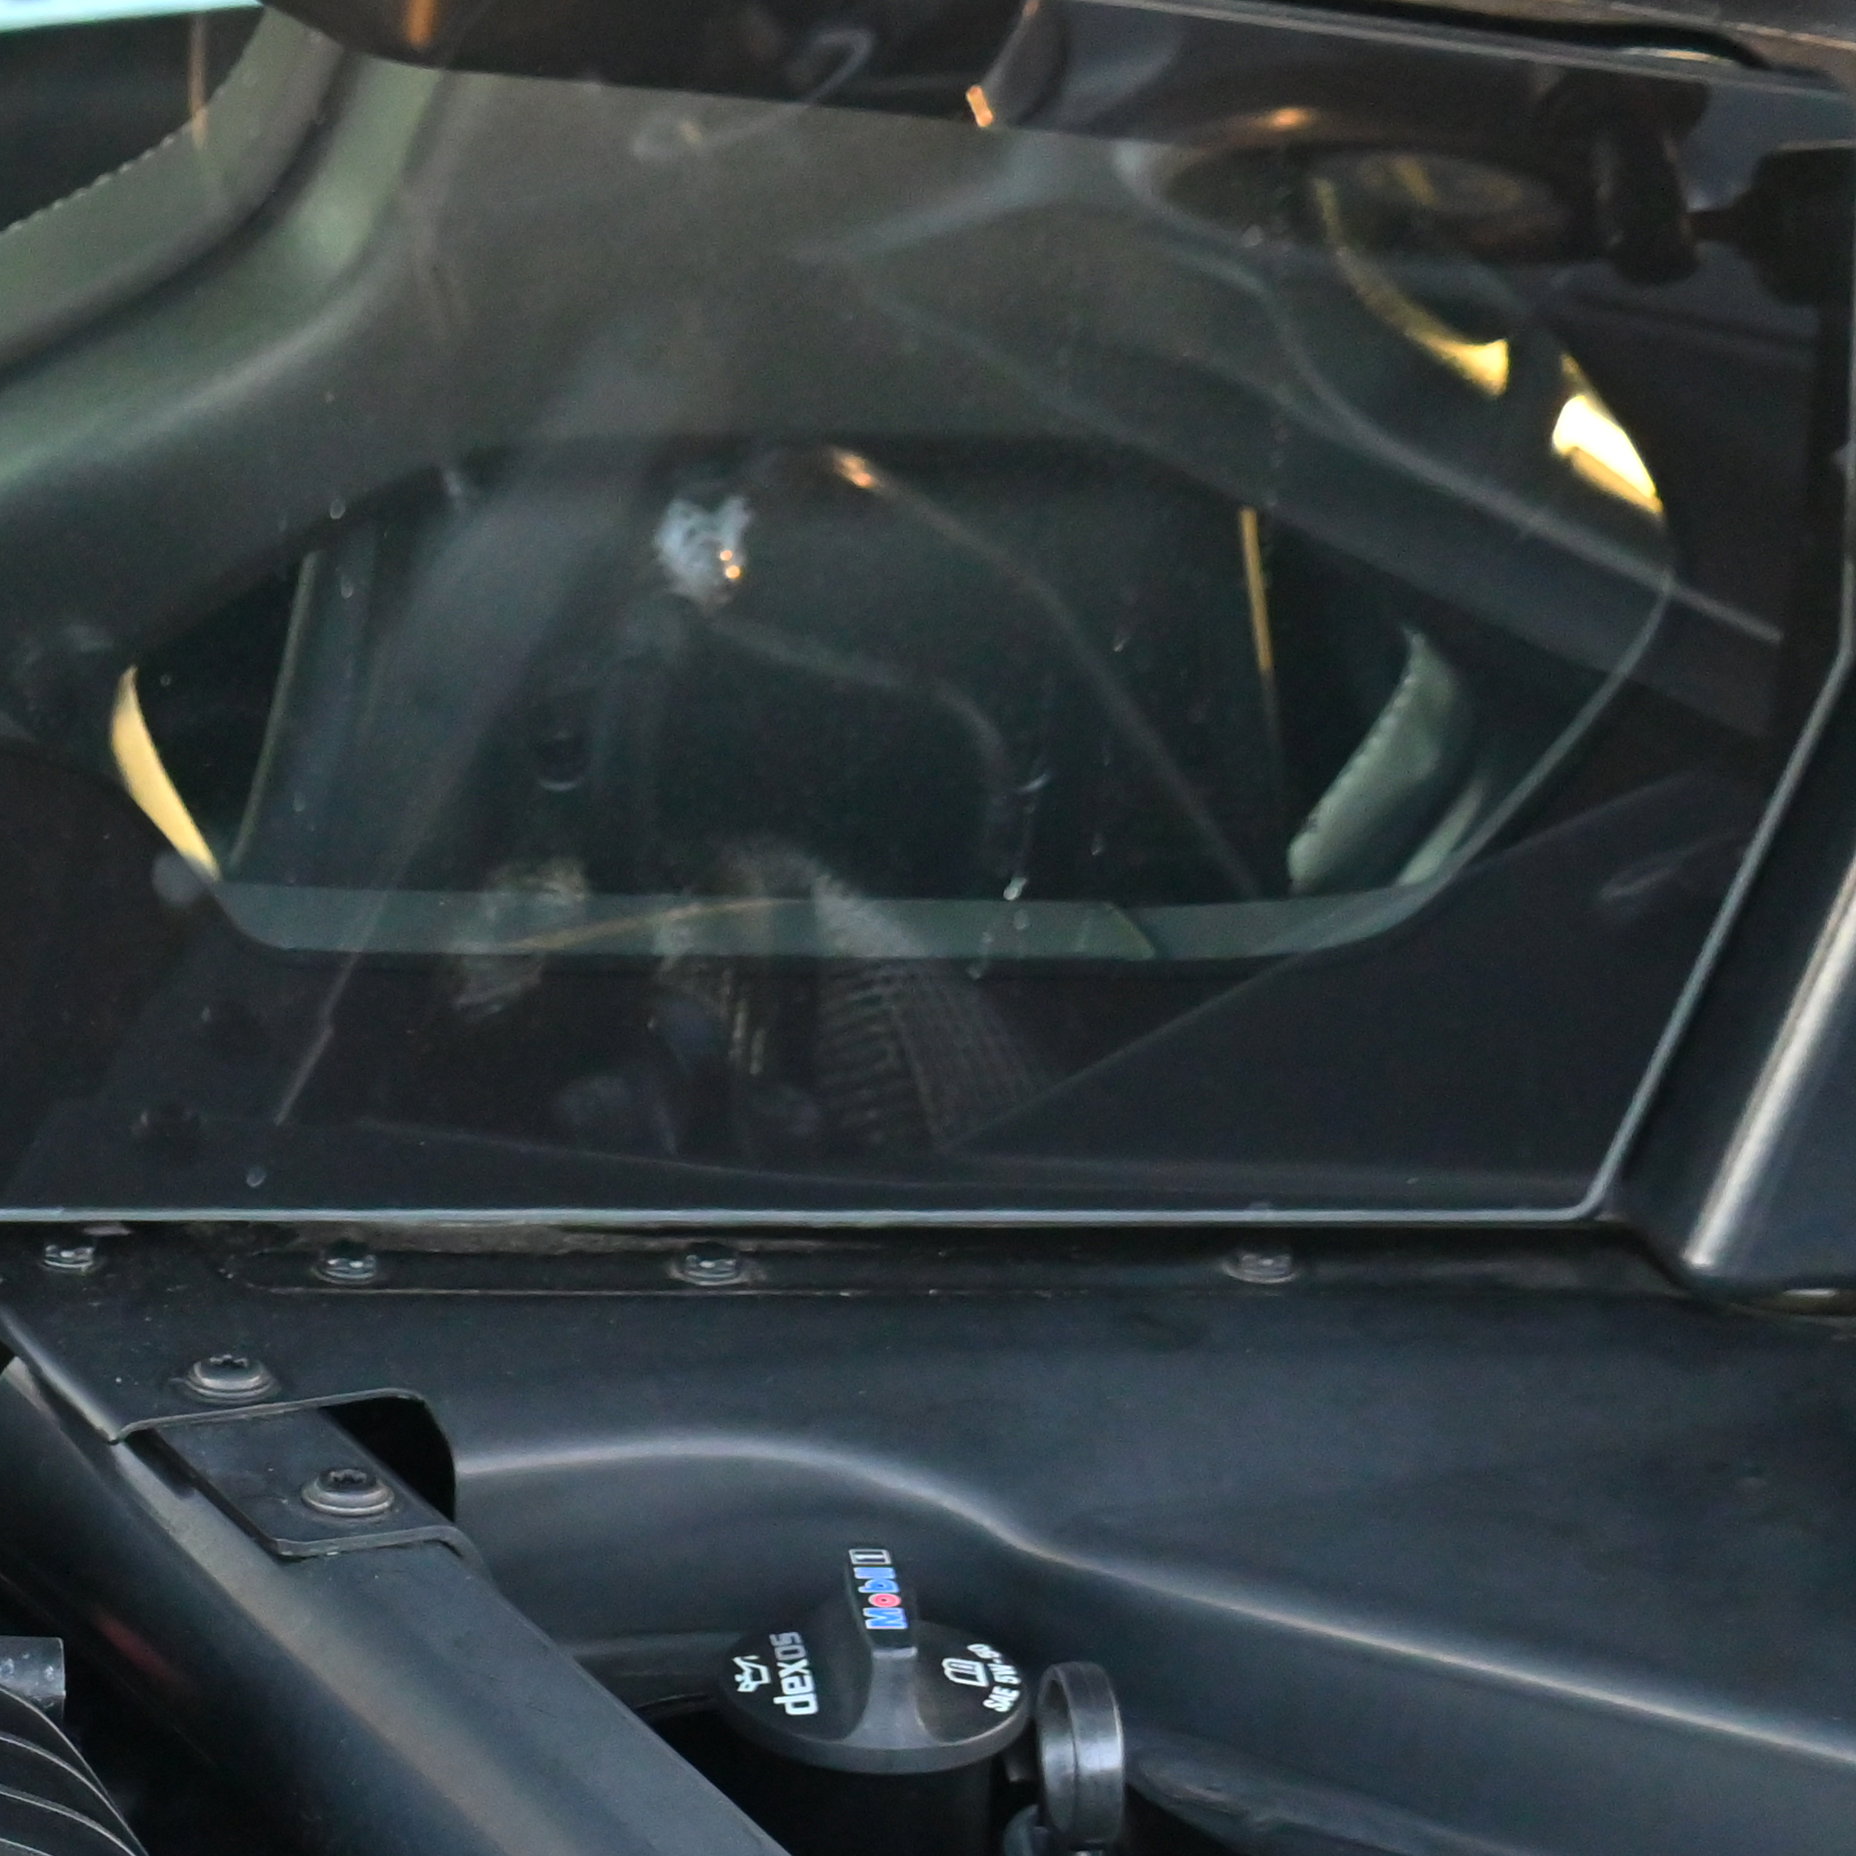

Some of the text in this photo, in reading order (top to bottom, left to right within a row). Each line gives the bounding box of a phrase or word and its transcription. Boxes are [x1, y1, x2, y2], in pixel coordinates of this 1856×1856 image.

[853, 1566, 908, 1630] Mobil
[769, 1631, 818, 1716] dexos
[983, 1686, 1020, 1713] SAE
